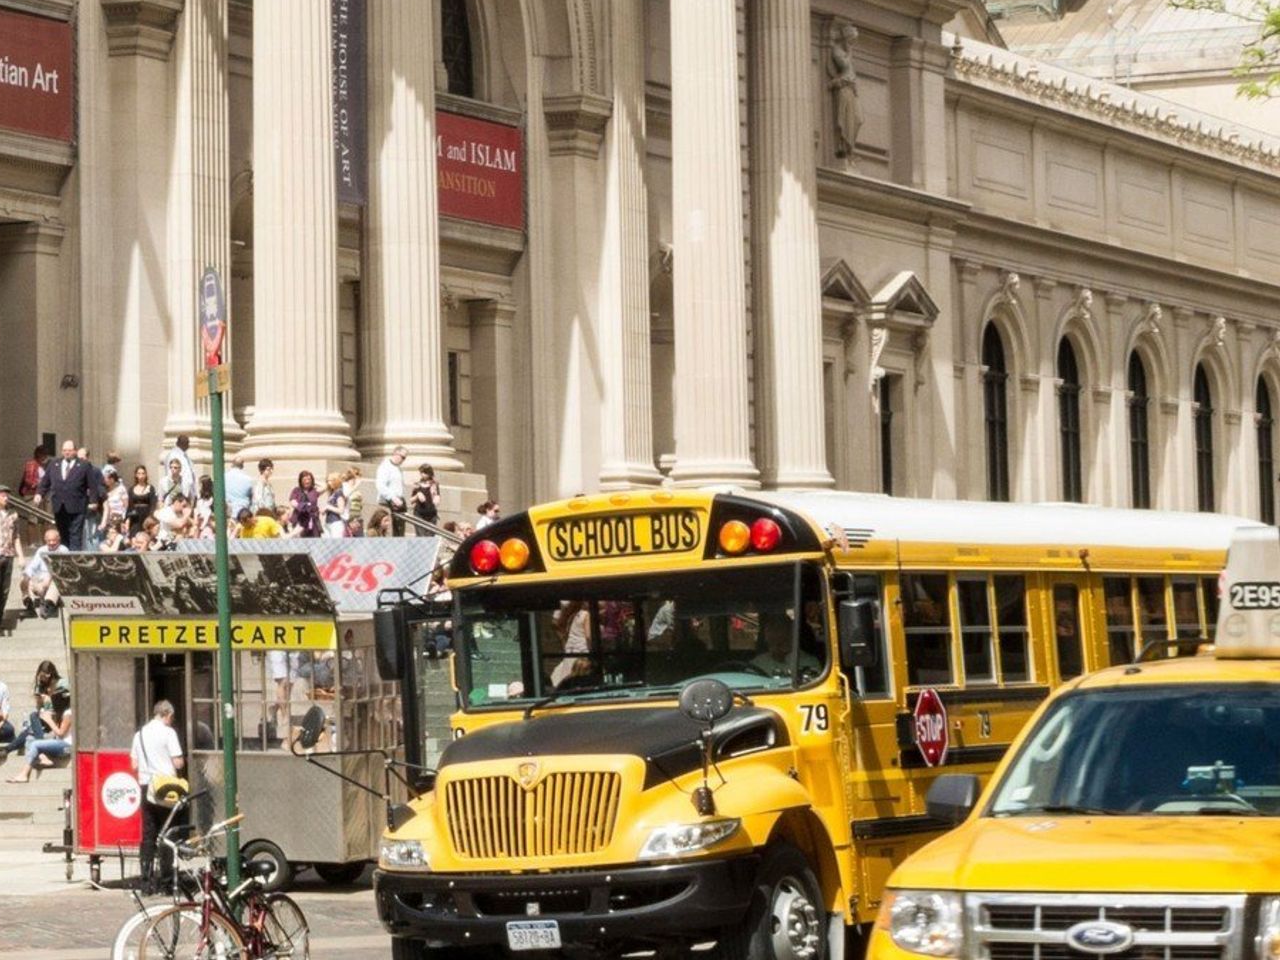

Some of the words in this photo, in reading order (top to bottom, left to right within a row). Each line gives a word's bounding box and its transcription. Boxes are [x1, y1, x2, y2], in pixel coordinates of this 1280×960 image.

[32, 63, 59, 94] Art
[338, 33, 348, 101] HOUSE
[339, 108, 349, 137] OF
[340, 142, 352, 187] ART
[446, 140, 467, 162] and
[470, 142, 517, 172] ISLAM
[555, 516, 642, 558] SCHOOL
[649, 511, 695, 550] BUS
[70, 600, 137, 612] Sigmund
[1231, 585, 1280, 608] 2E95
[230, 625, 307, 645] CART
[799, 703, 829, 732] 79
[920, 713, 943, 742] STOP
